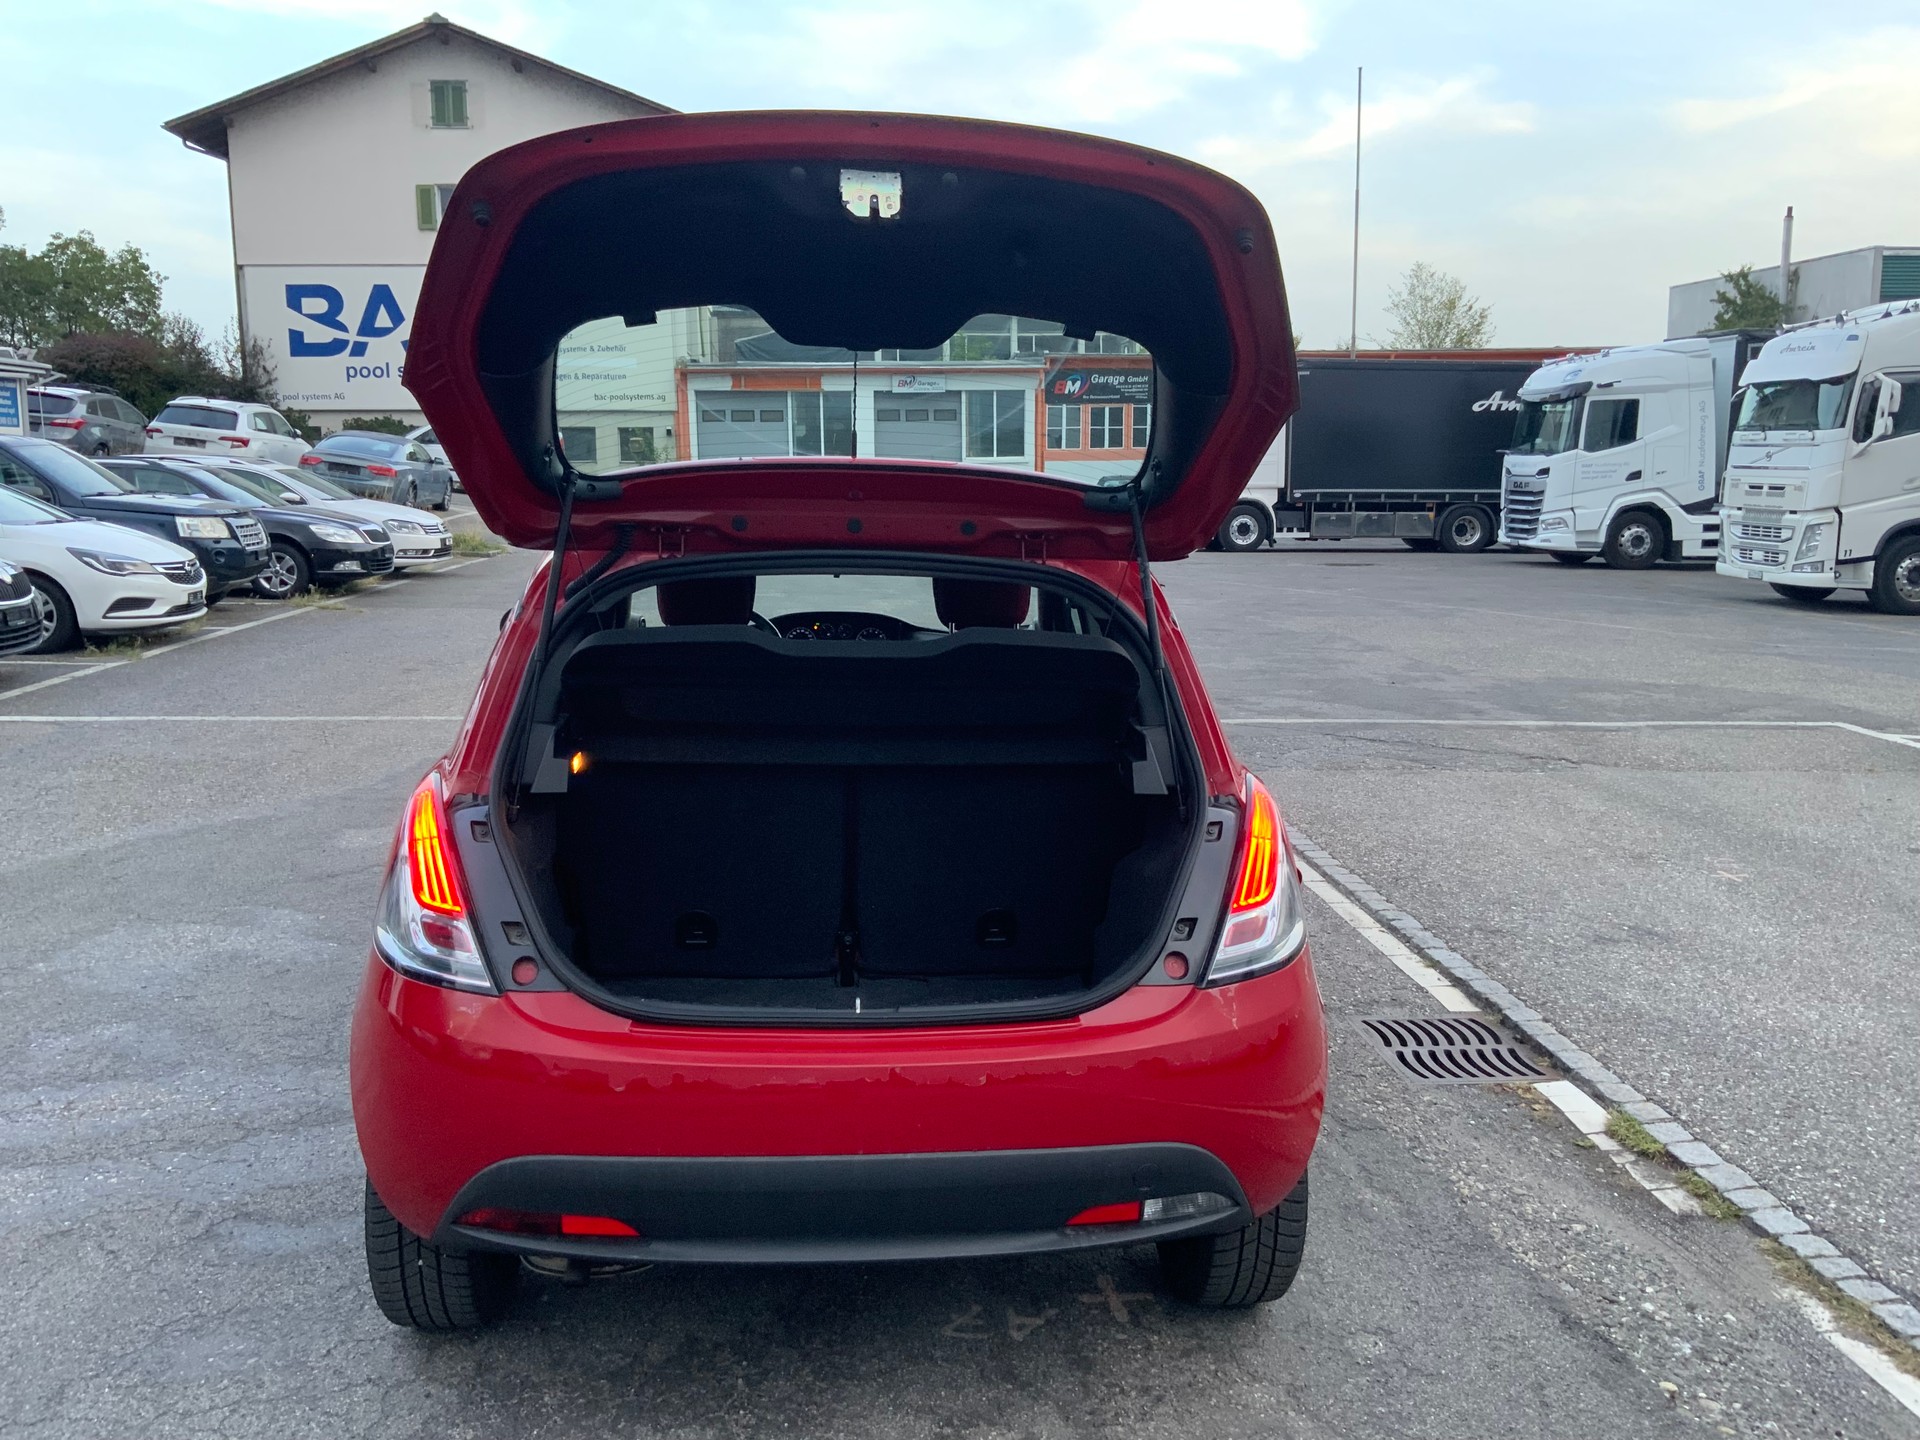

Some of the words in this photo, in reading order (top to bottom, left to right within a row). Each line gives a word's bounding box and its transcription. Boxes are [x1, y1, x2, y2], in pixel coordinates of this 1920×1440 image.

[285, 284, 409, 357] BA
[597, 344, 626, 352] Zubehör
[345, 362, 390, 382] pool
[581, 372, 627, 381] Reparaturen
[1091, 374, 1125, 385] Garage
[1127, 375, 1148, 383] GmbH
[1054, 380, 1081, 394] BM
[282, 392, 299, 402] pool
[301, 392, 332, 402] systems
[334, 392, 346, 400] AG
[594, 393, 666, 402] bac-poolsystems.ag
[1472, 390, 1521, 412] Am
